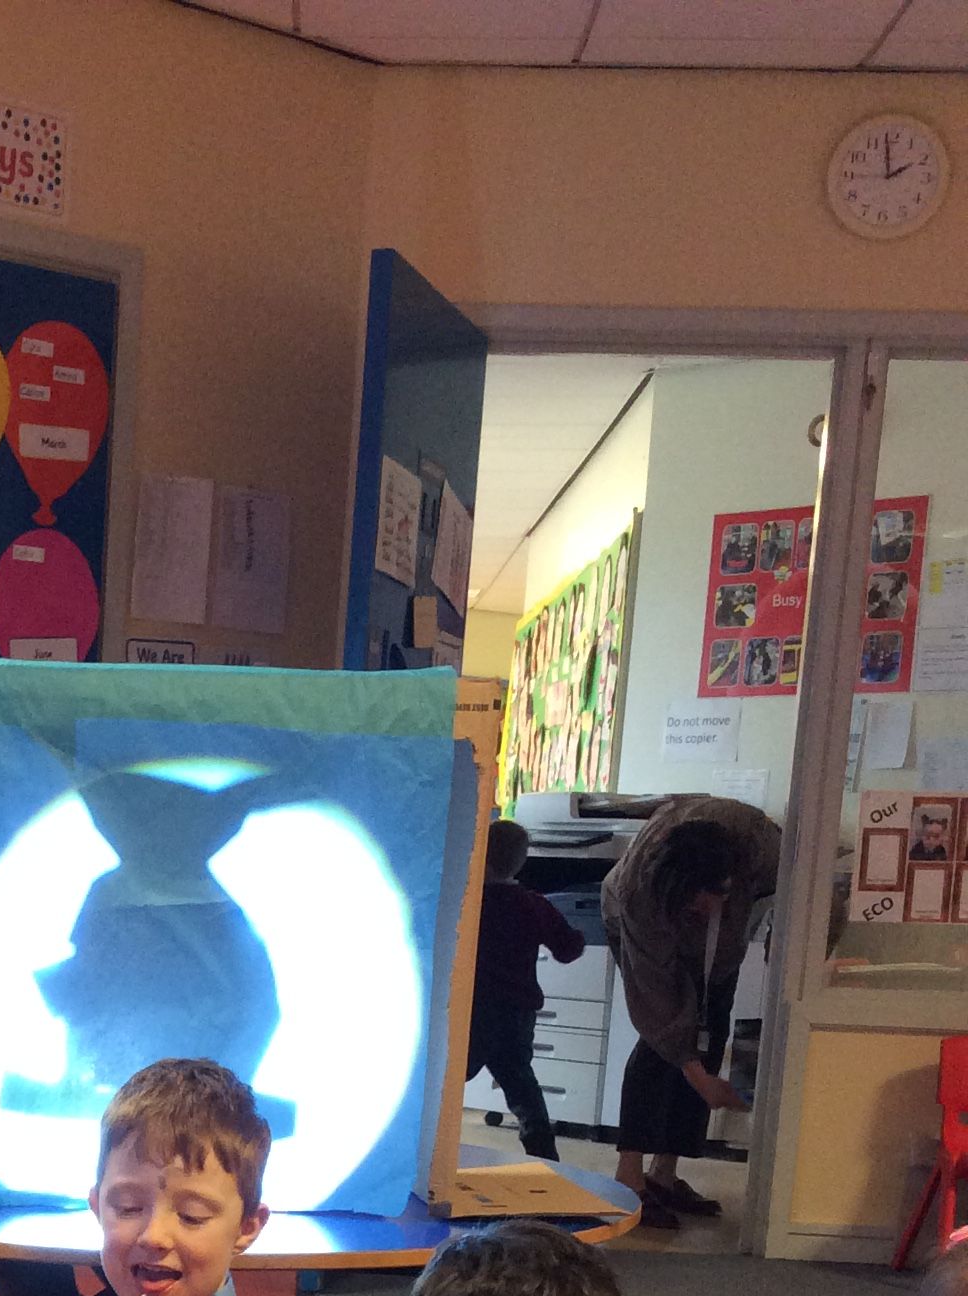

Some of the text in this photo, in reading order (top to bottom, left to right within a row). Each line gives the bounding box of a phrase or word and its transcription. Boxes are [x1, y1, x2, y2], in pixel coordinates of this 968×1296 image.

[866, 136, 879, 150] 11
[772, 593, 803, 608] Busy
[136, 647, 185, 664] We Are
[667, 716, 731, 728] Do not move
[665, 734, 683, 744] this
[869, 801, 899, 824] Our
[862, 897, 894, 922] ECO
